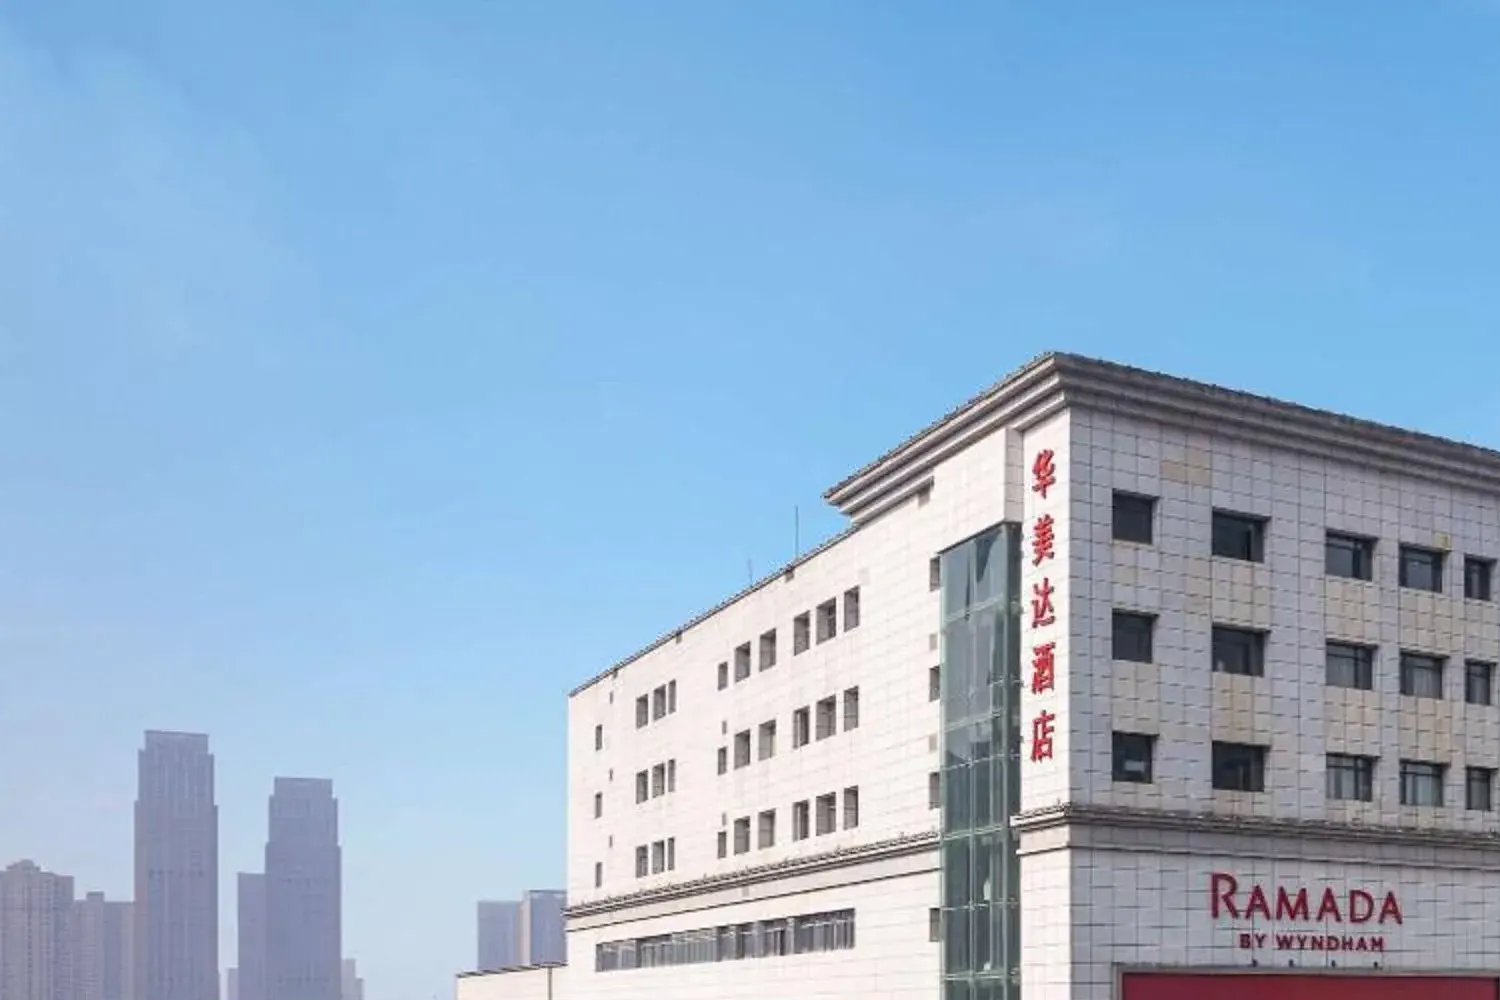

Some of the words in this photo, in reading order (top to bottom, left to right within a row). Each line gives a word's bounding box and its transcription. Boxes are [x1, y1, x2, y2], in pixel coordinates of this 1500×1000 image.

[1031, 448, 1056, 762] 华美达酒店
[1210, 872, 1403, 925] RAMADA
[1239, 933, 1268, 949] BY
[1275, 934, 1385, 952] WYNDHAM
